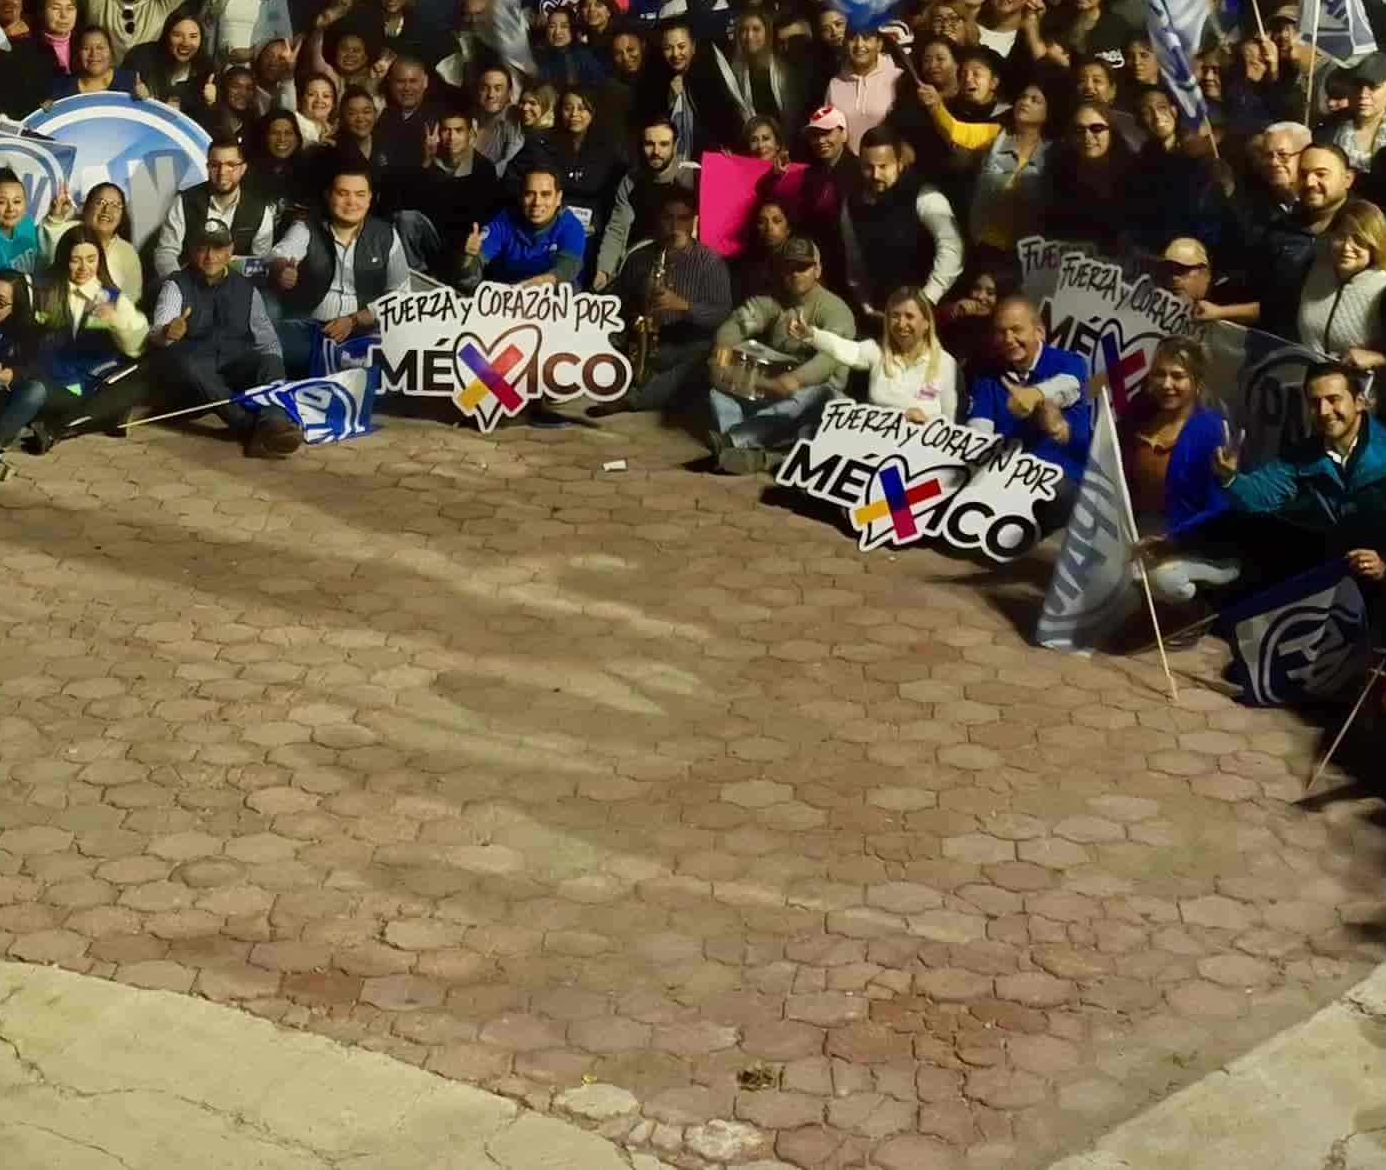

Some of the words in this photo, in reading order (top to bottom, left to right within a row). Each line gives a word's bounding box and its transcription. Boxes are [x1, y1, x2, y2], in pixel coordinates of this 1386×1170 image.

[377, 291, 458, 332] FUERZA
[477, 284, 570, 321] CORAZÓN
[574, 296, 621, 333] POR
[1062, 255, 1120, 302] FUERZA
[376, 330, 629, 410] MÉXICO
[821, 402, 905, 442] FUERZA
[920, 420, 1016, 473] CORAZÓN
[1003, 457, 1061, 496] POR
[780, 443, 1037, 558] MÉXICO
